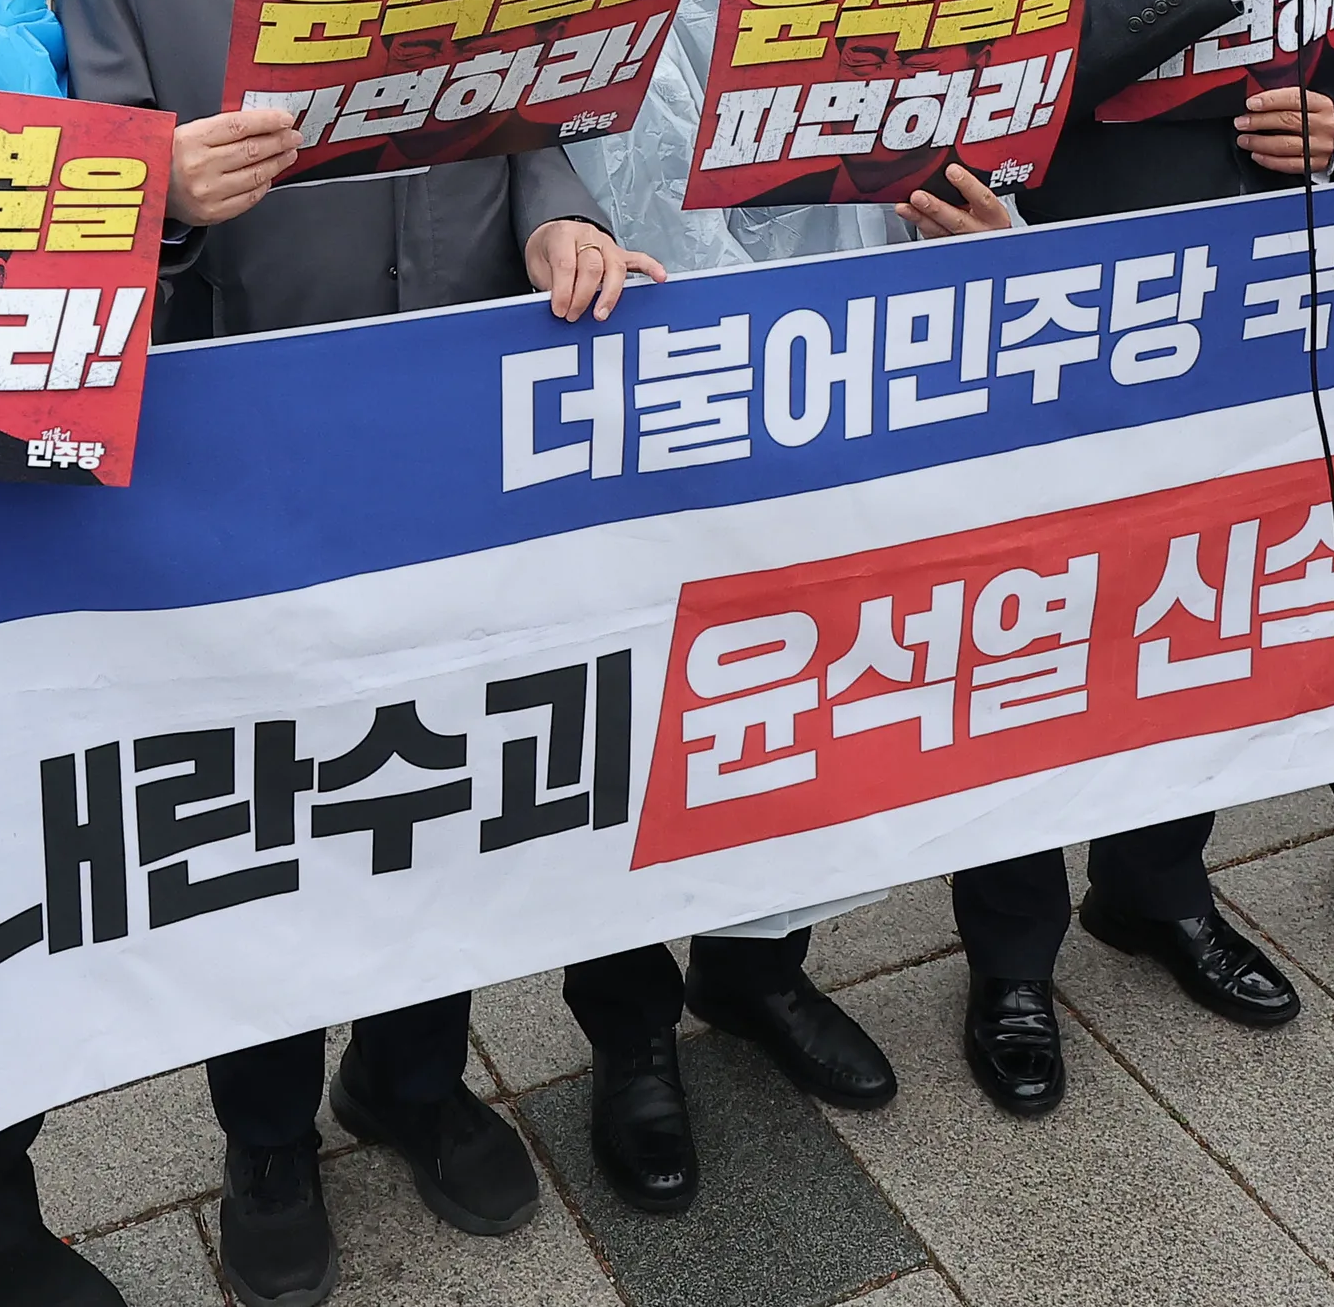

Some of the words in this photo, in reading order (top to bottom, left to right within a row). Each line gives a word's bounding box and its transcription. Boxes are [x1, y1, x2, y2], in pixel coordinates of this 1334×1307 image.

[559, 111, 618, 138] 민주당
[699, 47, 1074, 172] 파면하라!
[989, 162, 1034, 189] 민주당
[500, 243, 1217, 493] 더불어민주당
[27, 439, 106, 470] 민주당
[681, 554, 1098, 811] 윤석열
